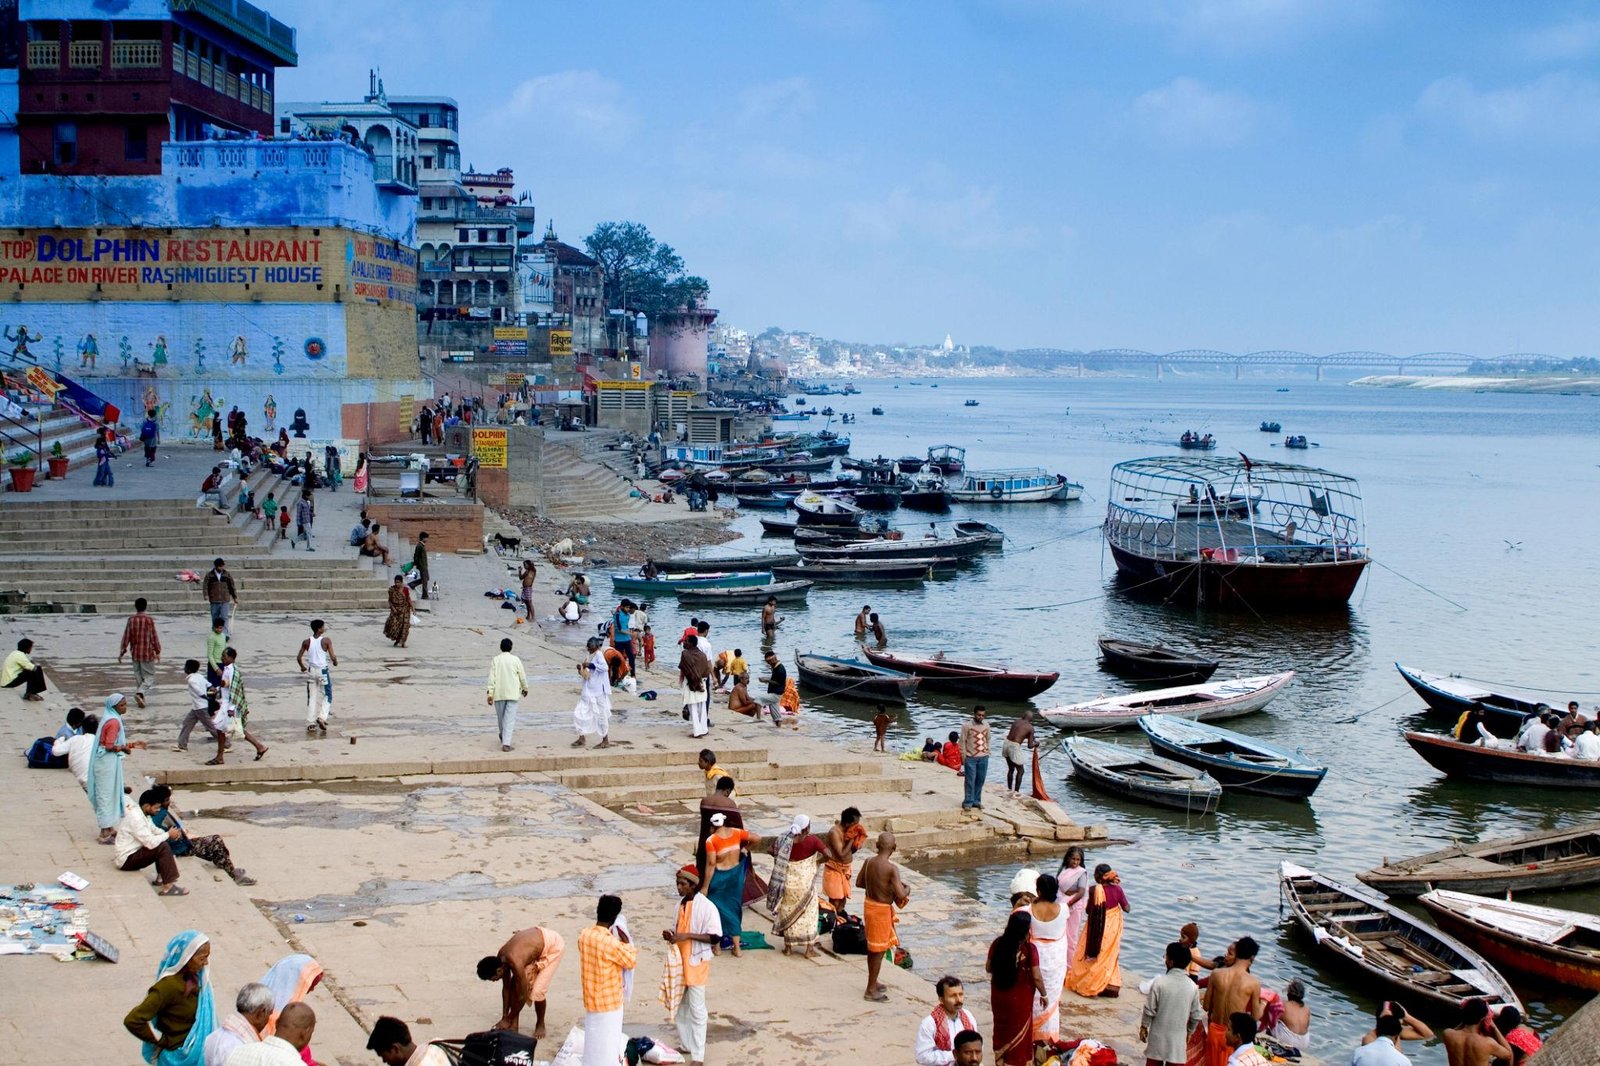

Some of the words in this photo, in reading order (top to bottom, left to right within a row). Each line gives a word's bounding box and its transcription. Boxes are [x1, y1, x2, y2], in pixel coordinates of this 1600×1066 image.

[37, 235, 160, 262] DOLPHIN
[166, 240, 323, 262] RESTAURANT
[0, 267, 63, 284] PALACE
[67, 267, 88, 284] ON
[92, 267, 138, 284] RIVER
[264, 267, 323, 283] HOUSE
[472, 431, 506, 439] DOLPHIN
